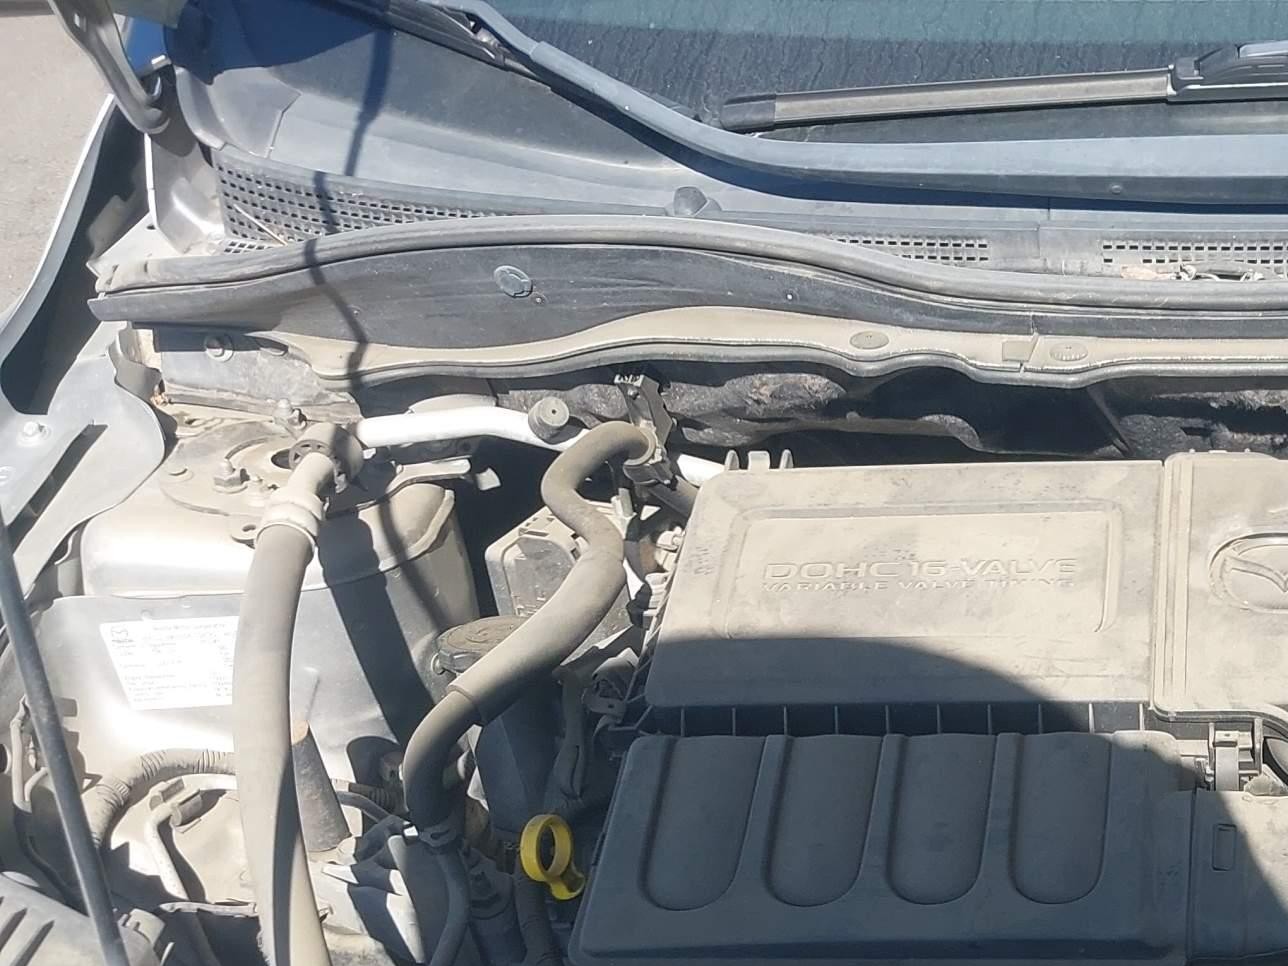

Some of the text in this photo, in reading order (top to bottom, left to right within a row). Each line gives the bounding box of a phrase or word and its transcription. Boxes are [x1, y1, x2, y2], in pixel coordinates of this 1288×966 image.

[764, 561, 901, 580] DOHC
[762, 581, 888, 592] VARIABLE
[898, 579, 971, 591] VALVE
